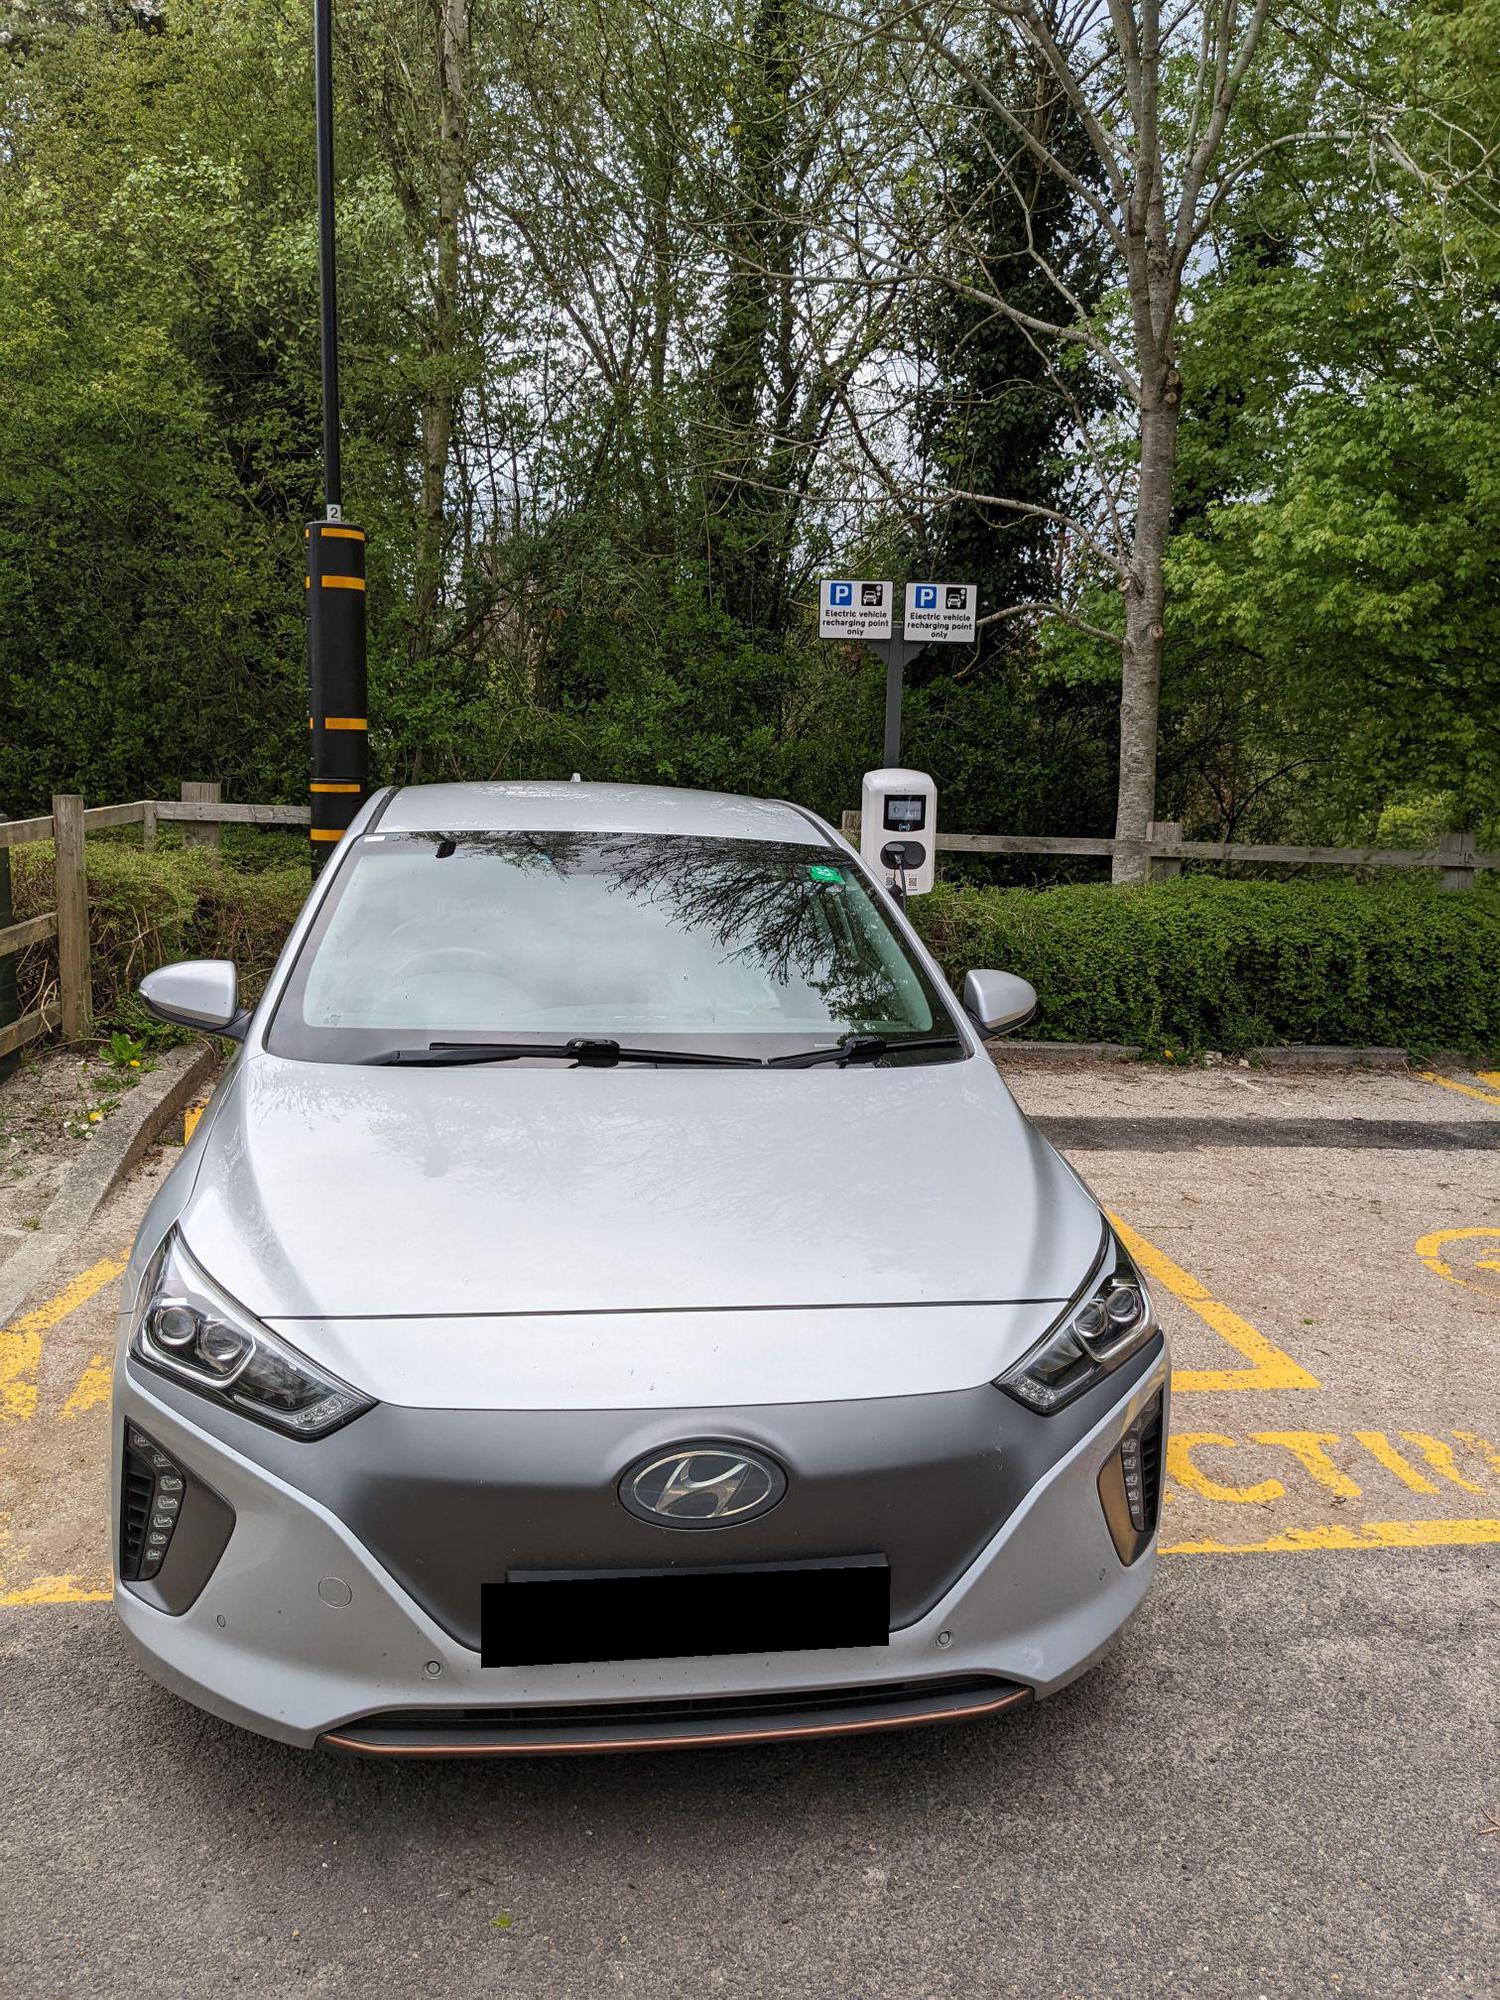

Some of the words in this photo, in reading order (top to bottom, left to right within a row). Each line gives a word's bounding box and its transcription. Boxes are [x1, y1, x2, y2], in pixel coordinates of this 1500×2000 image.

[330, 507, 339, 519] 2
[835, 585, 849, 604] P
[920, 588, 934, 607] P
[825, 609, 857, 618] Electric
[858, 610, 887, 618] vehicle
[910, 612, 941, 621] Electric
[942, 613, 971, 622] vehicle
[822, 619, 866, 628] recharging
[868, 619, 889, 627] point
[907, 621, 950, 631] recharging
[951, 622, 972, 631] point
[846, 628, 865, 637] only
[930, 631, 948, 640] only
